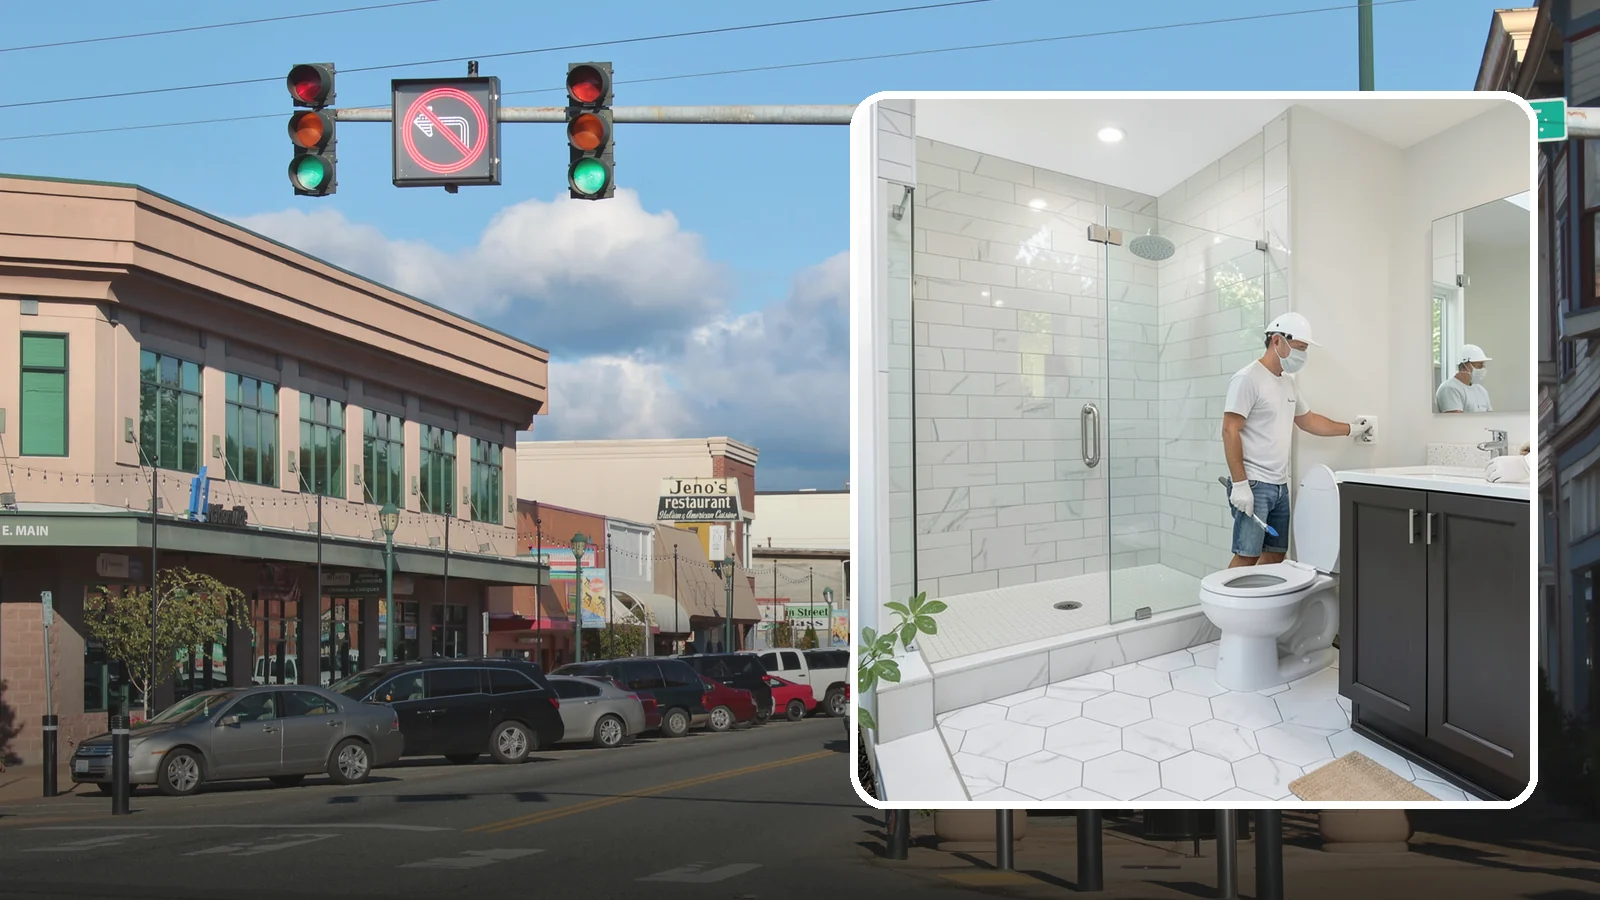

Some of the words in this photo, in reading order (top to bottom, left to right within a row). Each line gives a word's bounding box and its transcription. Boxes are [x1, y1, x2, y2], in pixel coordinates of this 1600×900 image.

[670, 480, 727, 494] Jeno's
[665, 496, 731, 509] restaurant
[659, 510, 681, 520] Italian
[686, 510, 714, 519] American
[715, 509, 737, 519] Cuisine
[2, 525, 13, 536] E.
[15, 525, 49, 537] MAIN
[797, 607, 828, 617] Street
[791, 619, 823, 627] lass
